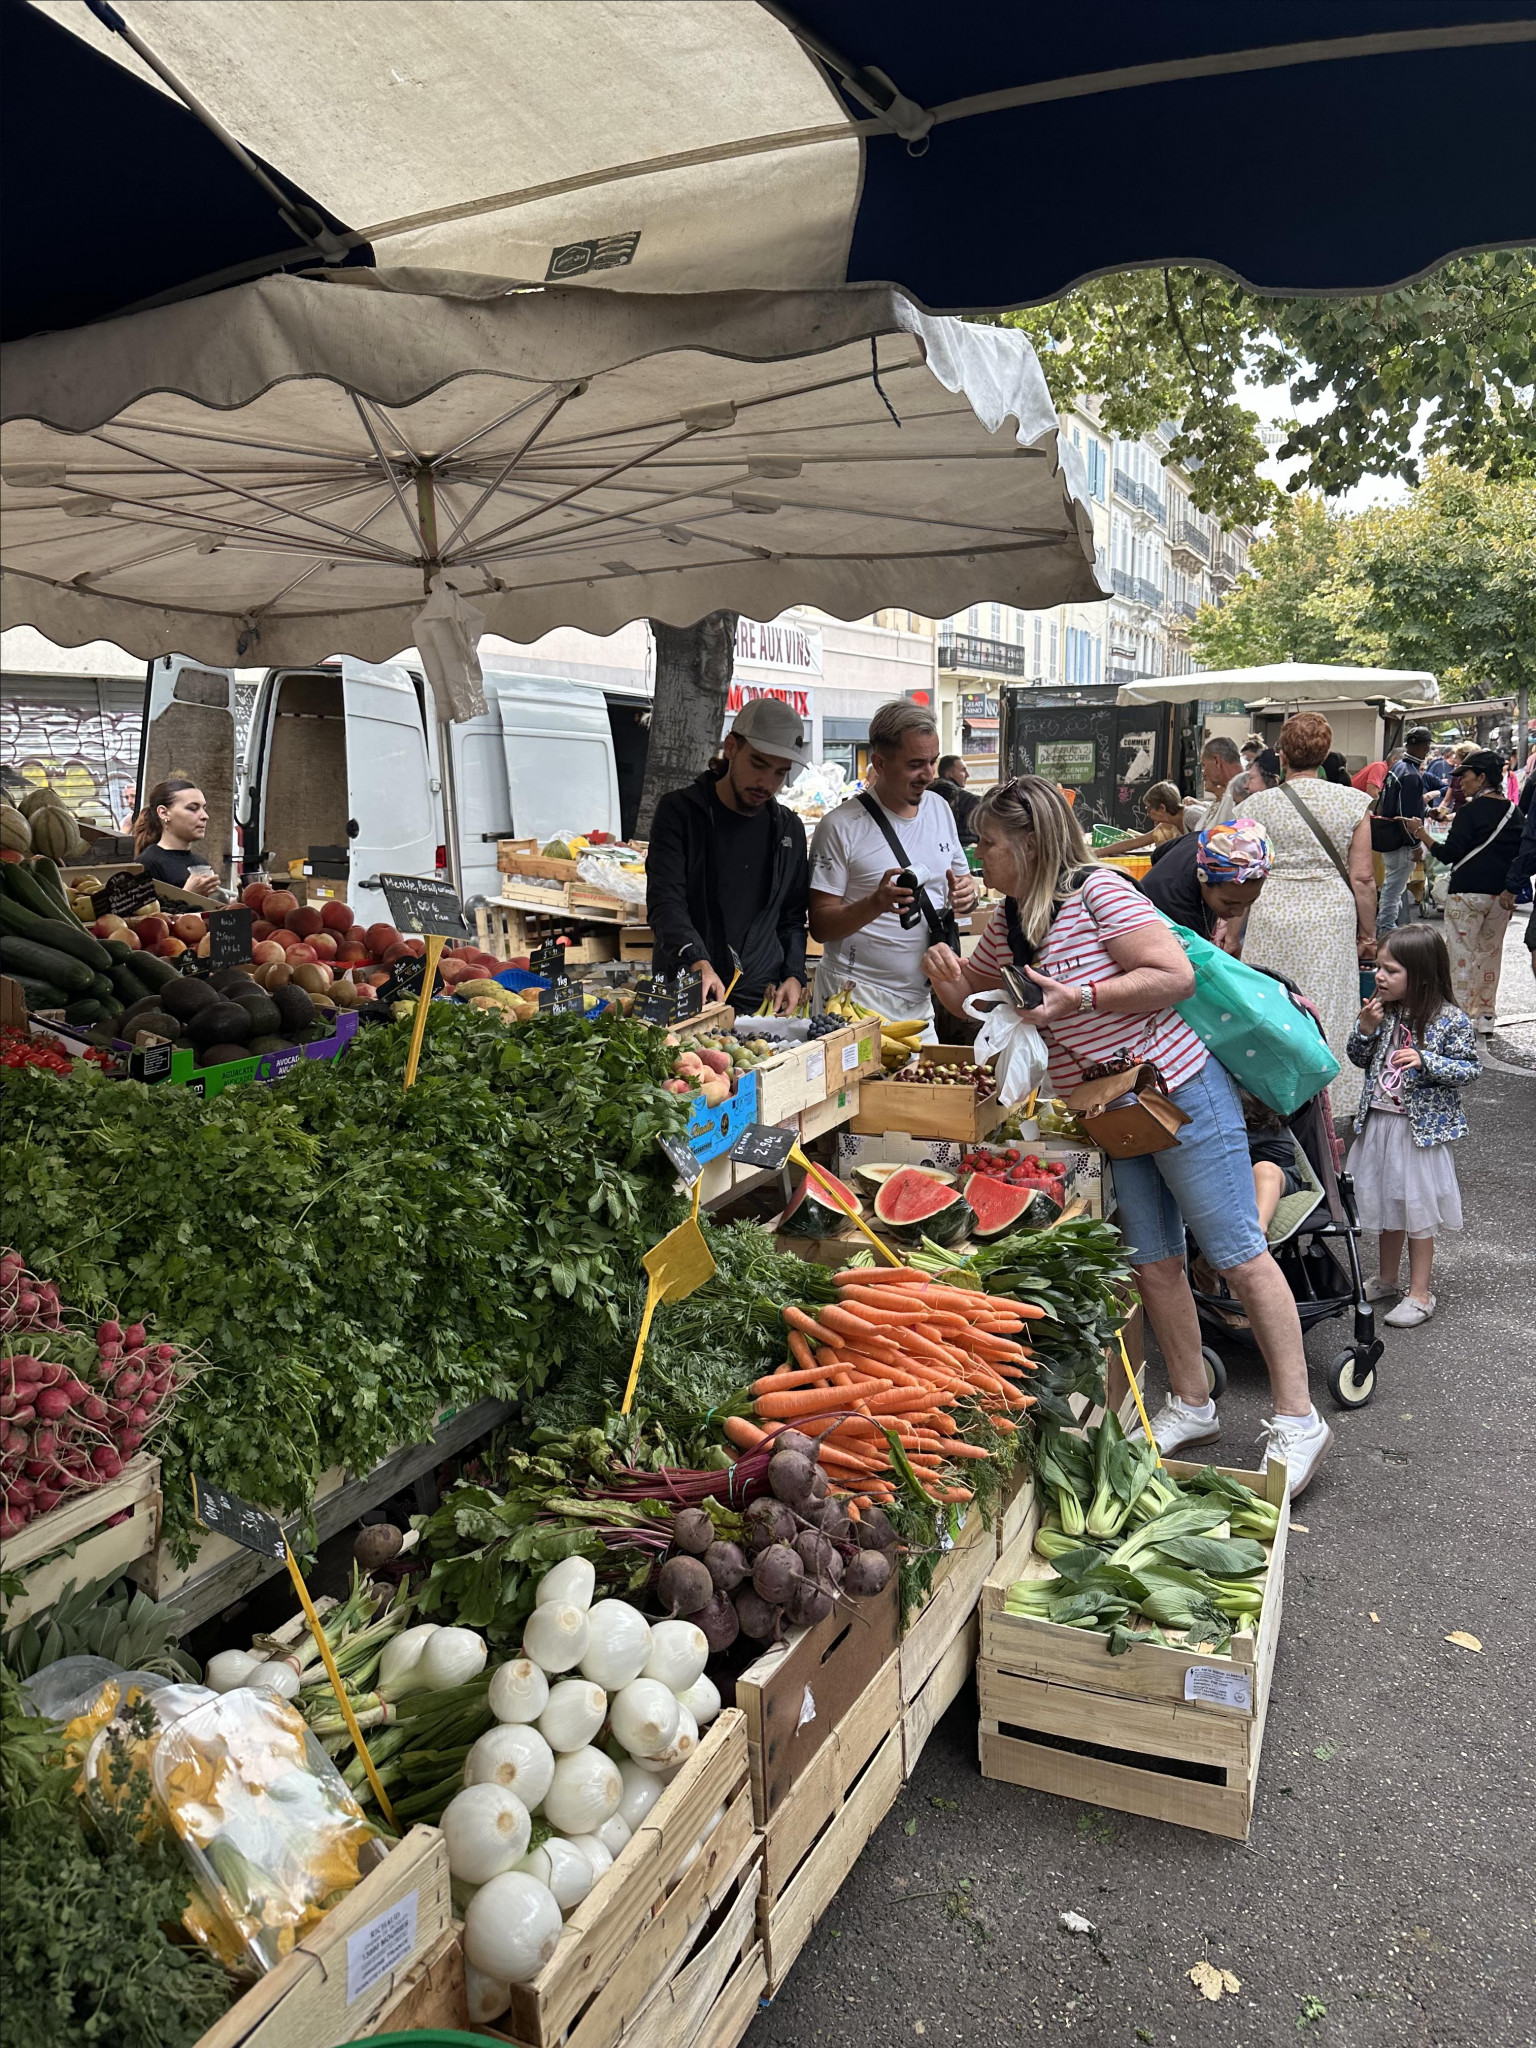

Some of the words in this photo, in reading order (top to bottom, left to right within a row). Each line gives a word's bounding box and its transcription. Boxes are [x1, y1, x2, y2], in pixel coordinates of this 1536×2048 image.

[760, 625, 783, 663] AUX
[784, 629, 811, 667] VINS
[1123, 738, 1150, 746] COMMENT
[222, 1066, 254, 1079] AGUACATE
[370, 1911, 400, 1938] RICHAUD
